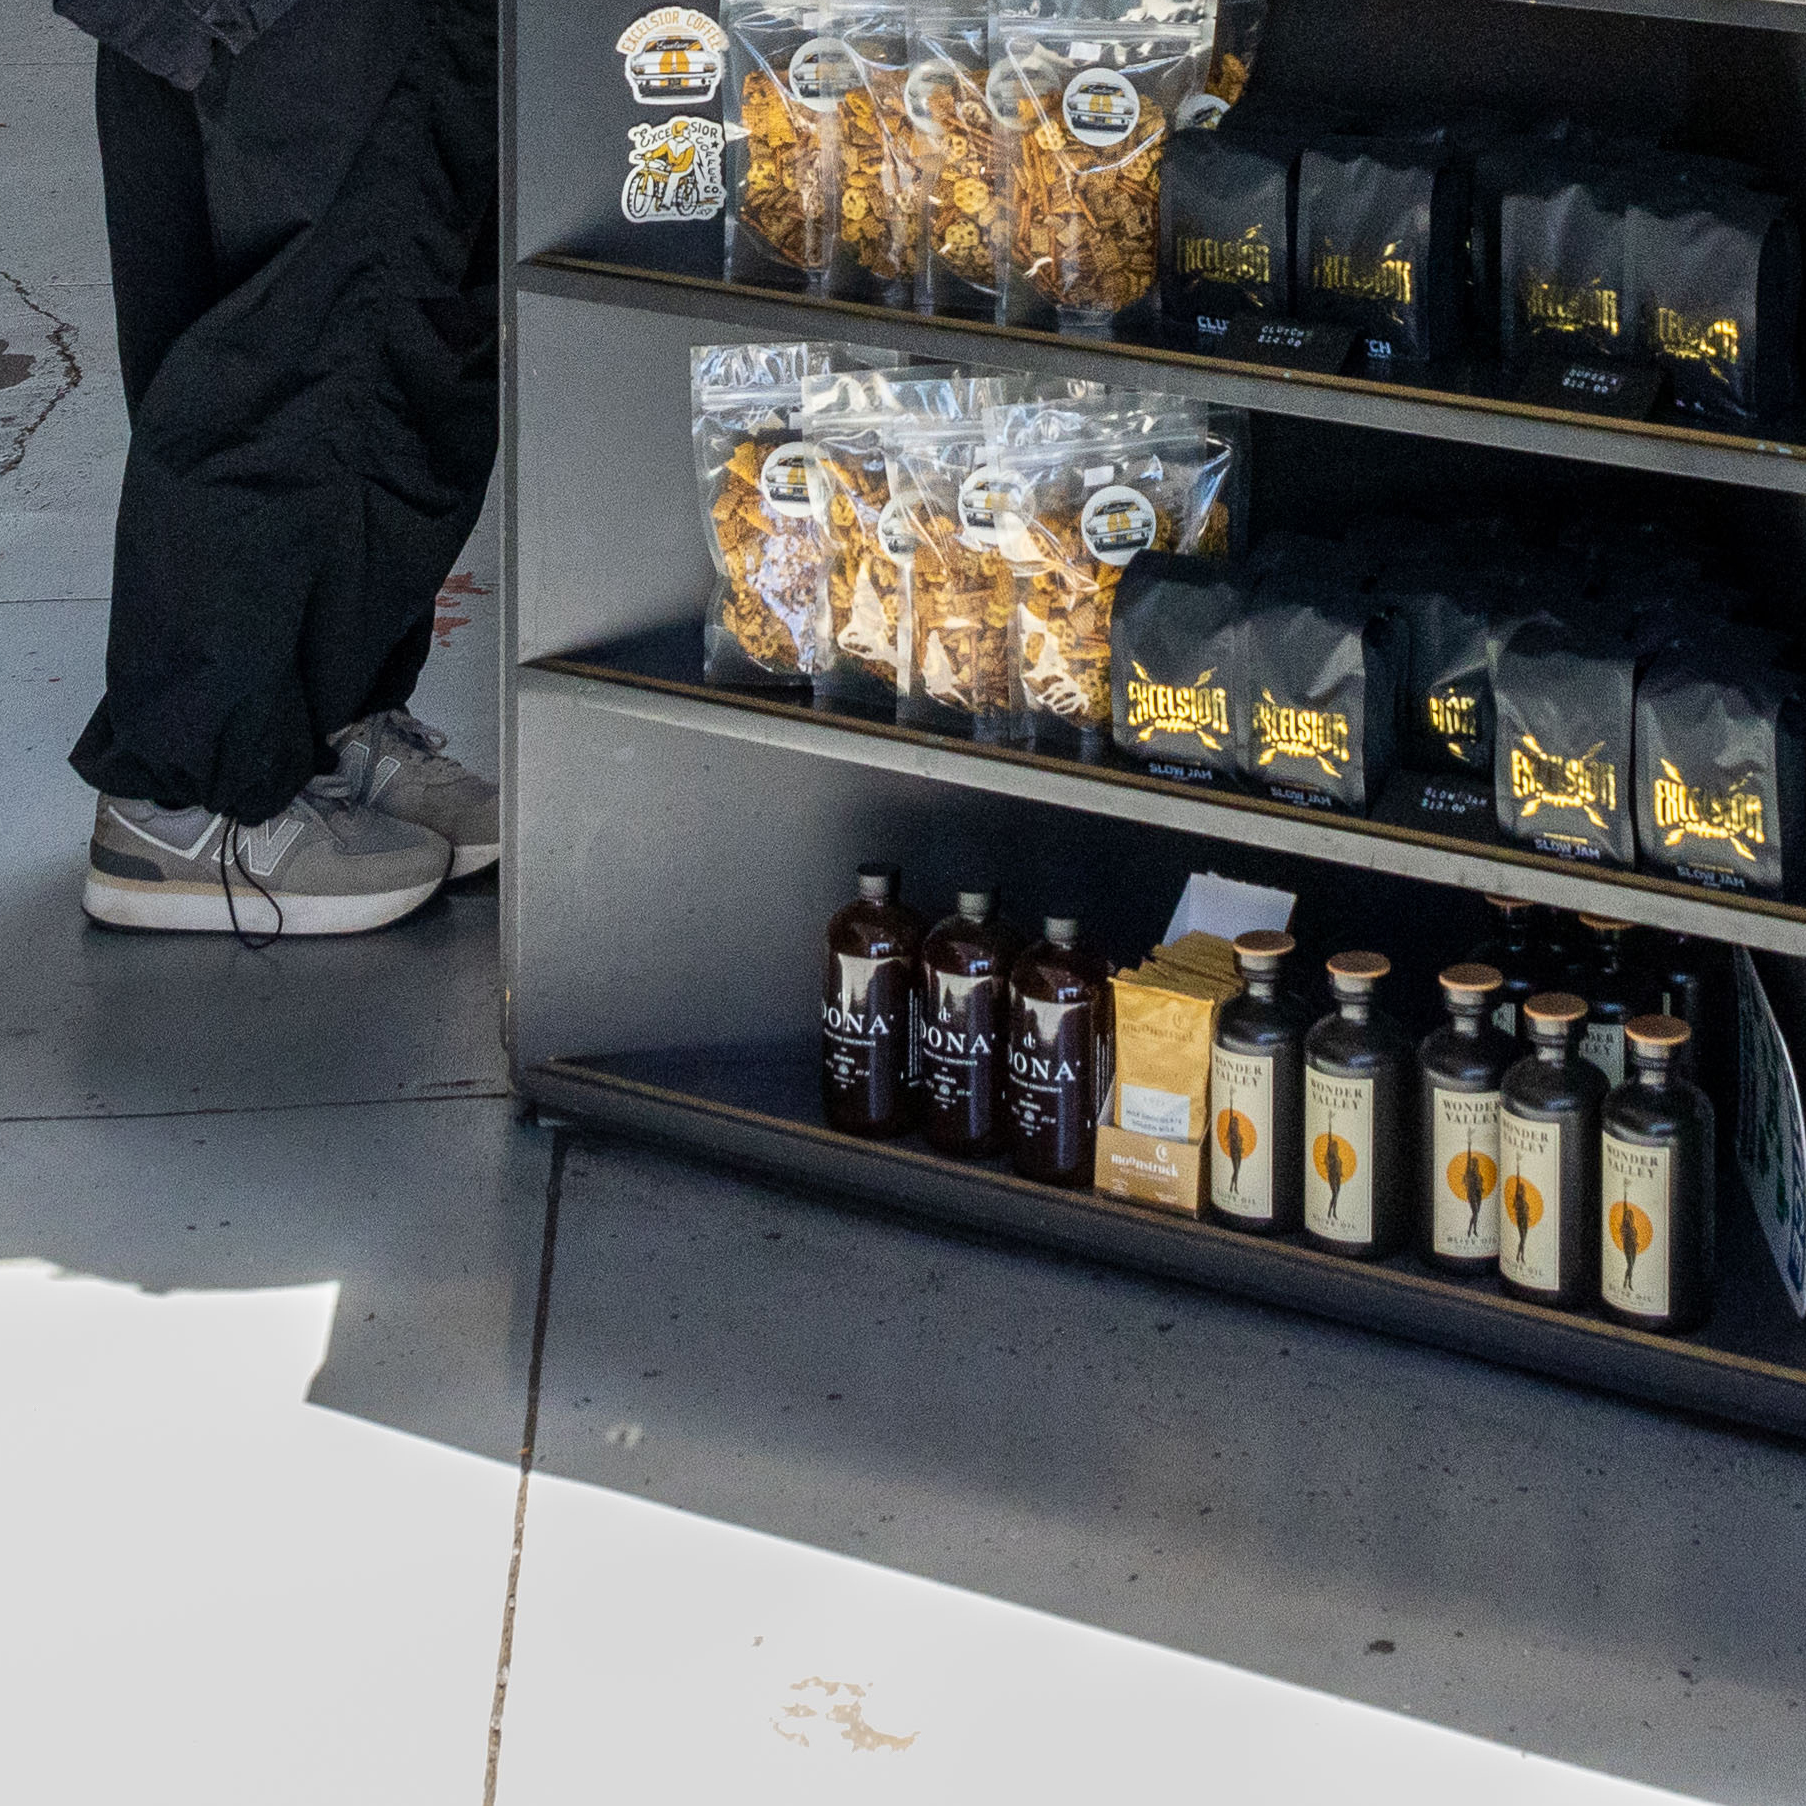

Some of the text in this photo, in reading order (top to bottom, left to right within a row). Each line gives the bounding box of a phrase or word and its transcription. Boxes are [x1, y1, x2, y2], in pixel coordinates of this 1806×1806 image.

[621, 10, 724, 53] EXCELSIOR COFFEE
[694, 136, 717, 185] COFFEE
[1196, 314, 1230, 331] CLU
[1366, 338, 1392, 354] CH
[1127, 681, 1230, 735] EXCELSIOR
[1253, 701, 1350, 763] EXCELSIOR
[1149, 762, 1214, 781] SLOW JAM
[1270, 785, 1332, 805] SLOW JAM
[1534, 838, 1600, 860] SLOW JAM
[1676, 864, 1746, 890] SLOW JAM
[1214, 1054, 1263, 1077] WONDER
[1214, 1067, 1259, 1089] VALLEY
[1310, 1077, 1364, 1100] WONDER
[1310, 1090, 1360, 1112] VALLEY
[1502, 1118, 1550, 1144] WONDER
[1502, 1132, 1546, 1156] VALLEY
[1606, 1142, 1660, 1168] WONDER
[1111, 1153, 1179, 1178] moonstruck
[1607, 1157, 1655, 1181] VALLEY
